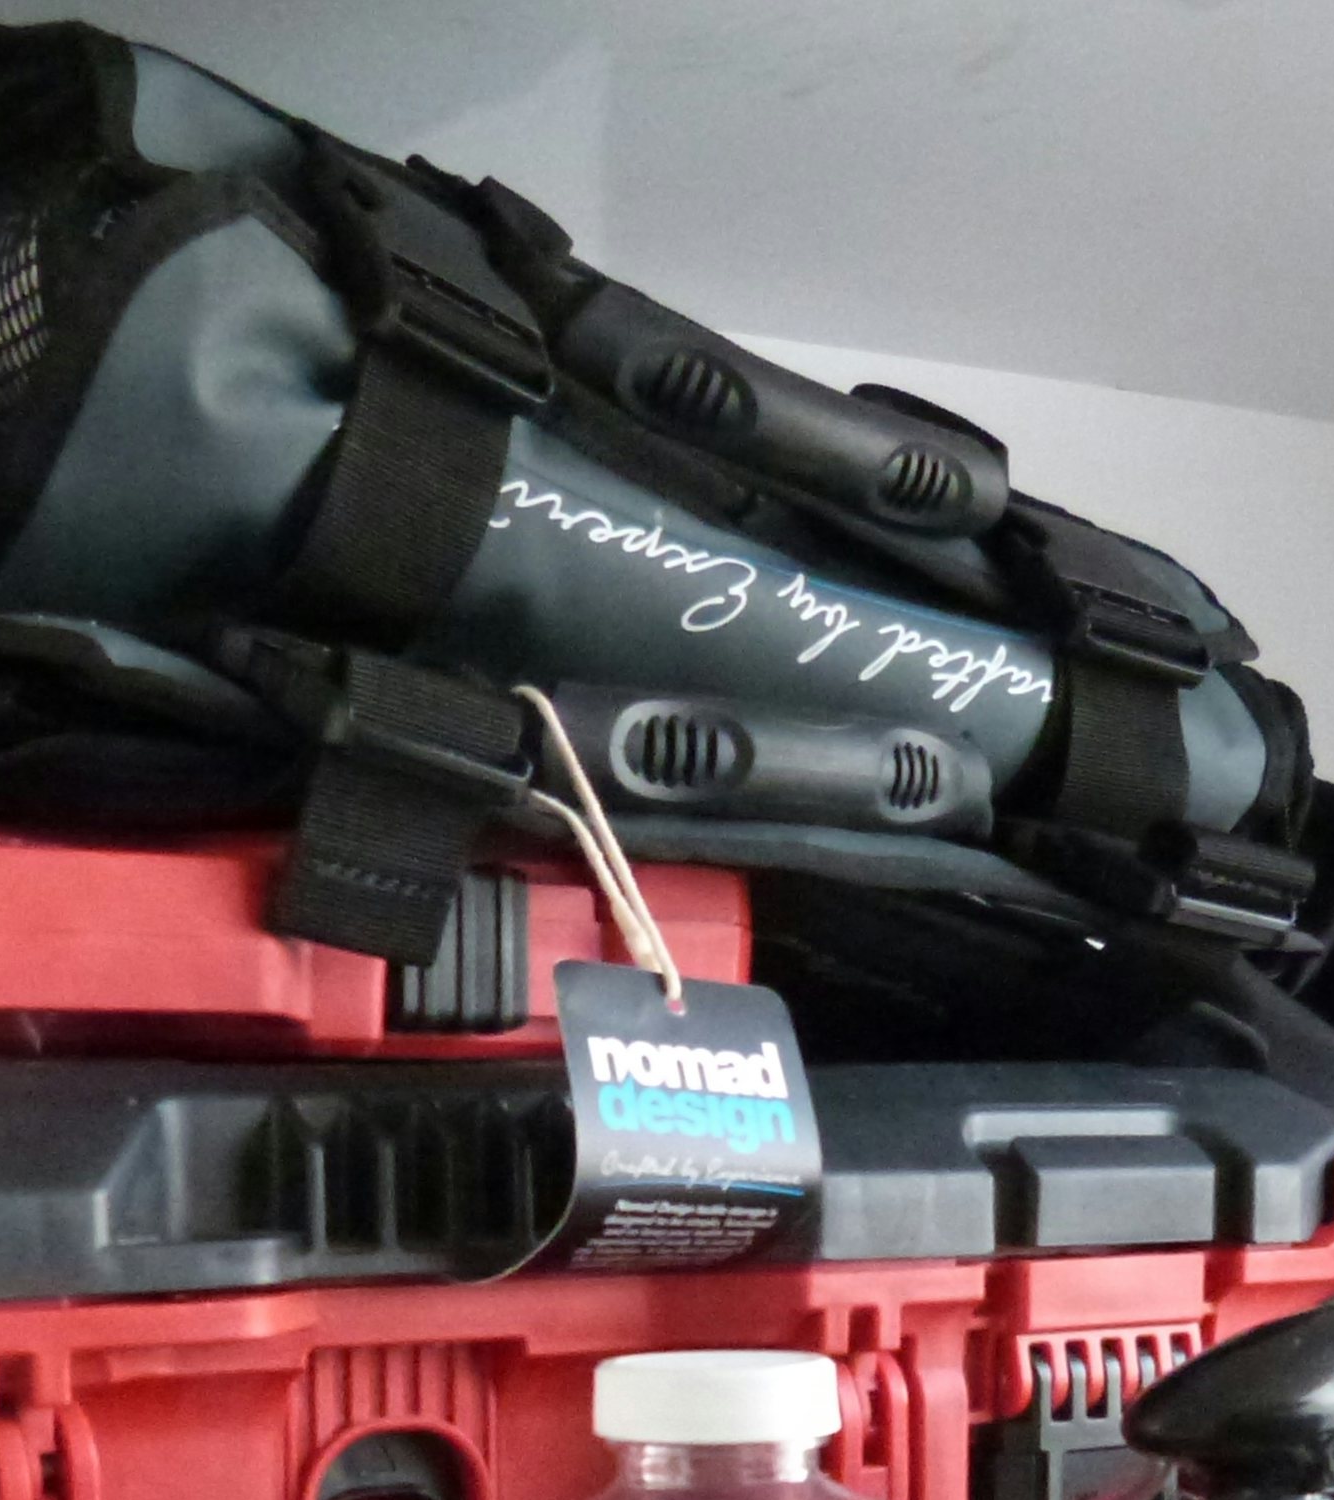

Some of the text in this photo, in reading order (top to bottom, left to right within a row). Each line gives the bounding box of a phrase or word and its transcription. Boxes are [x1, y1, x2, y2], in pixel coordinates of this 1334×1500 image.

[777, 574, 860, 664] by
[587, 1036, 788, 1099] nomad
[598, 1079, 795, 1154] design
